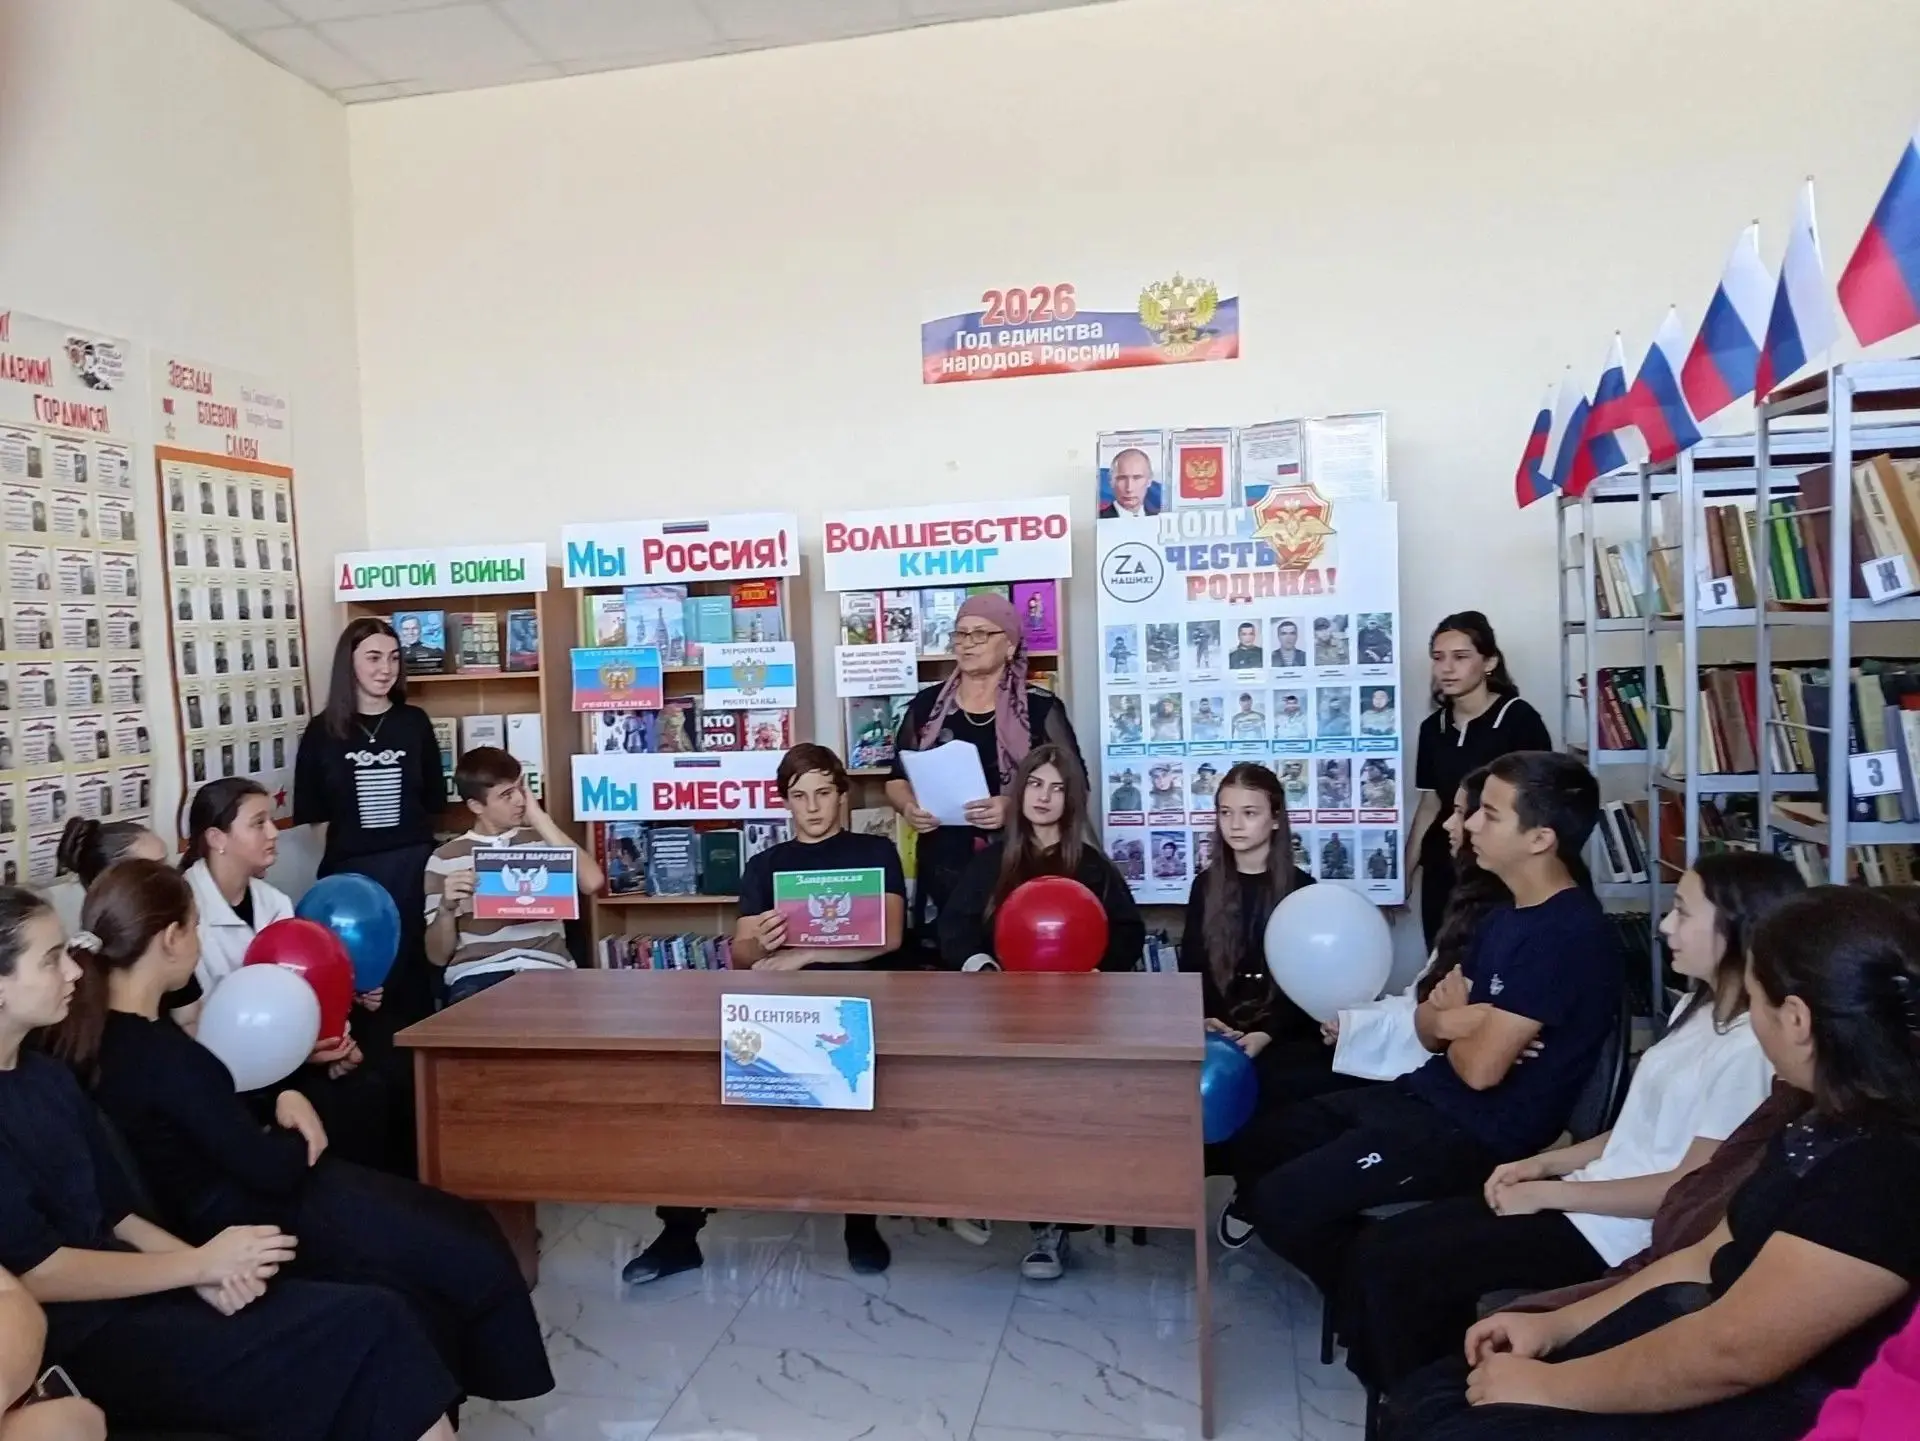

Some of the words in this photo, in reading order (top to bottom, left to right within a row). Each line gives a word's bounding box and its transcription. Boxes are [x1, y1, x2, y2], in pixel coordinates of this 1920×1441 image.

[979, 282, 1077, 326] 2026
[954, 329, 992, 351] Год
[997, 322, 1104, 347] единства
[940, 350, 1034, 379] народов
[1040, 342, 1122, 366] России
[33, 394, 110, 433] ГОРДИМСЯ!
[825, 514, 1068, 553] ВОЛШЕБСТВО
[1158, 507, 1247, 545] ДОЛГ
[900, 548, 998, 577] КНИГ
[1165, 541, 1276, 571] ЧЕСТЬ
[1186, 567, 1337, 604] РОДИНА!
[703, 715, 735, 728] КТО
[704, 732, 736, 746] КТО
[727, 1004, 750, 1023] 30
[754, 1010, 821, 1024] СЕНТЯБРЯ
